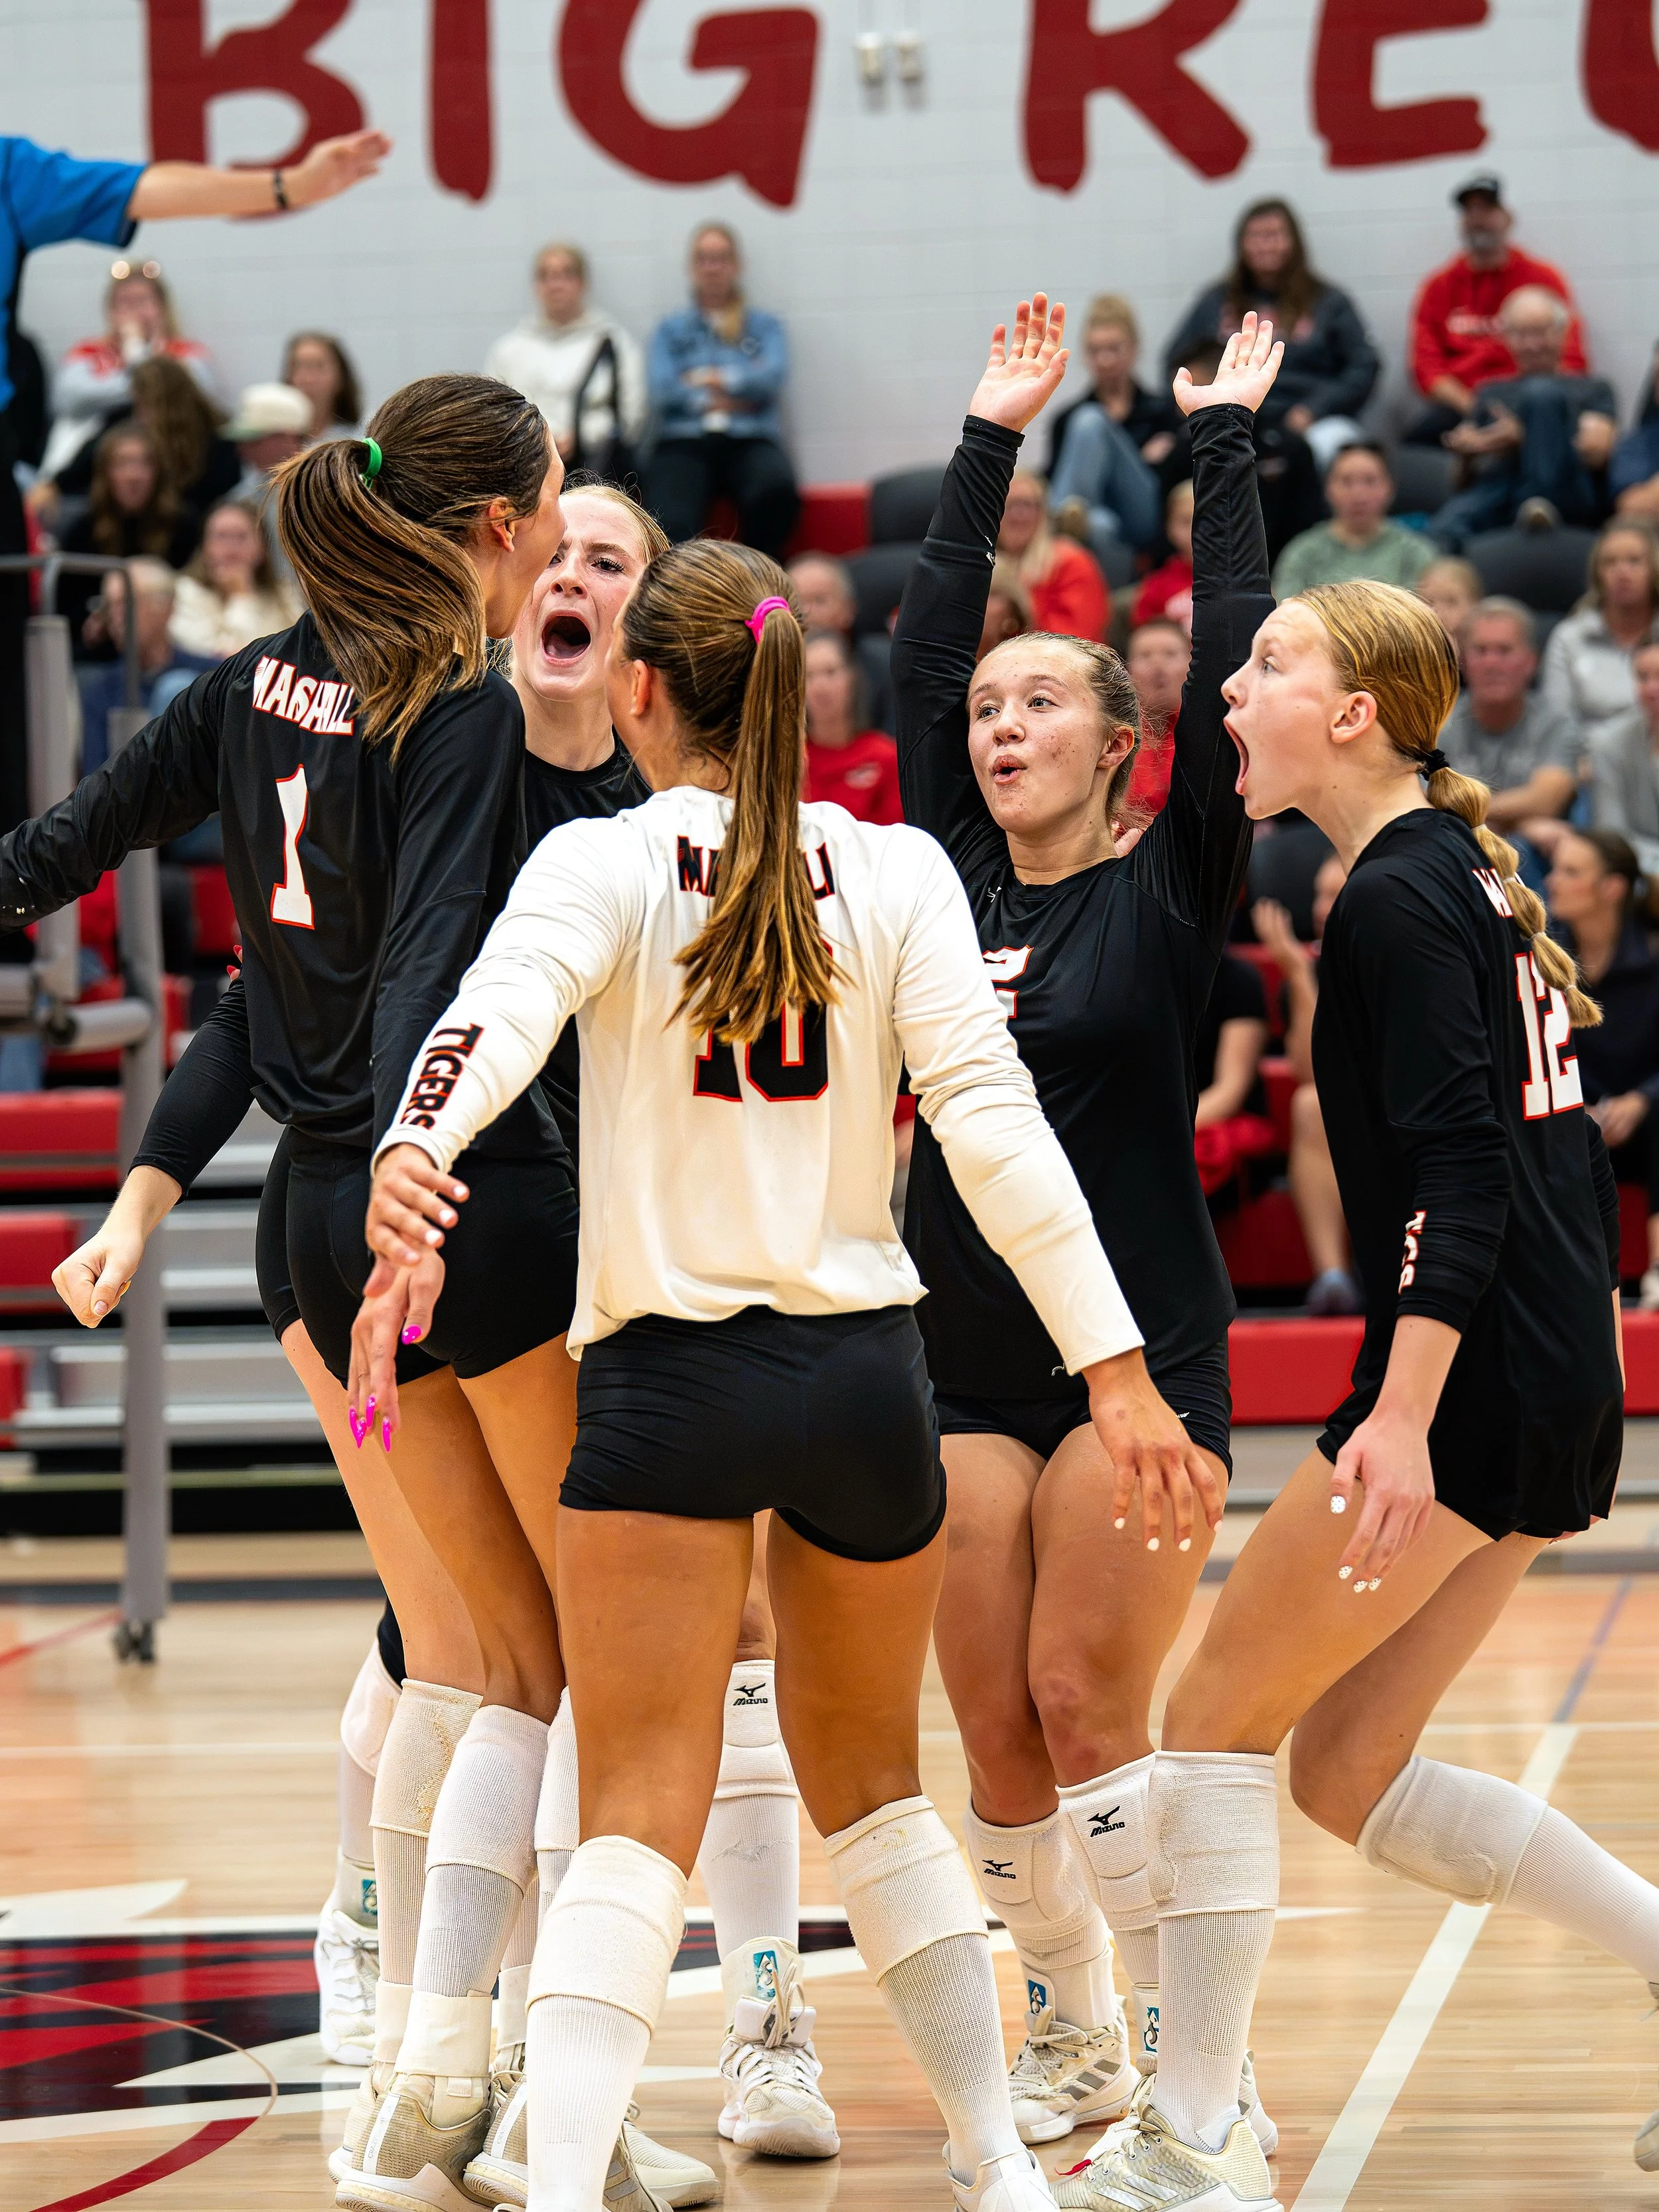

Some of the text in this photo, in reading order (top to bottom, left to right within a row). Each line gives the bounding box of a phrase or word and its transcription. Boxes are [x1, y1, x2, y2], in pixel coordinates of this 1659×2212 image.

[1022, 0, 1659, 194] RE
[271, 763, 315, 930] 1
[399, 1023, 484, 1130] TIGERS
[1514, 950, 1584, 1120] 12
